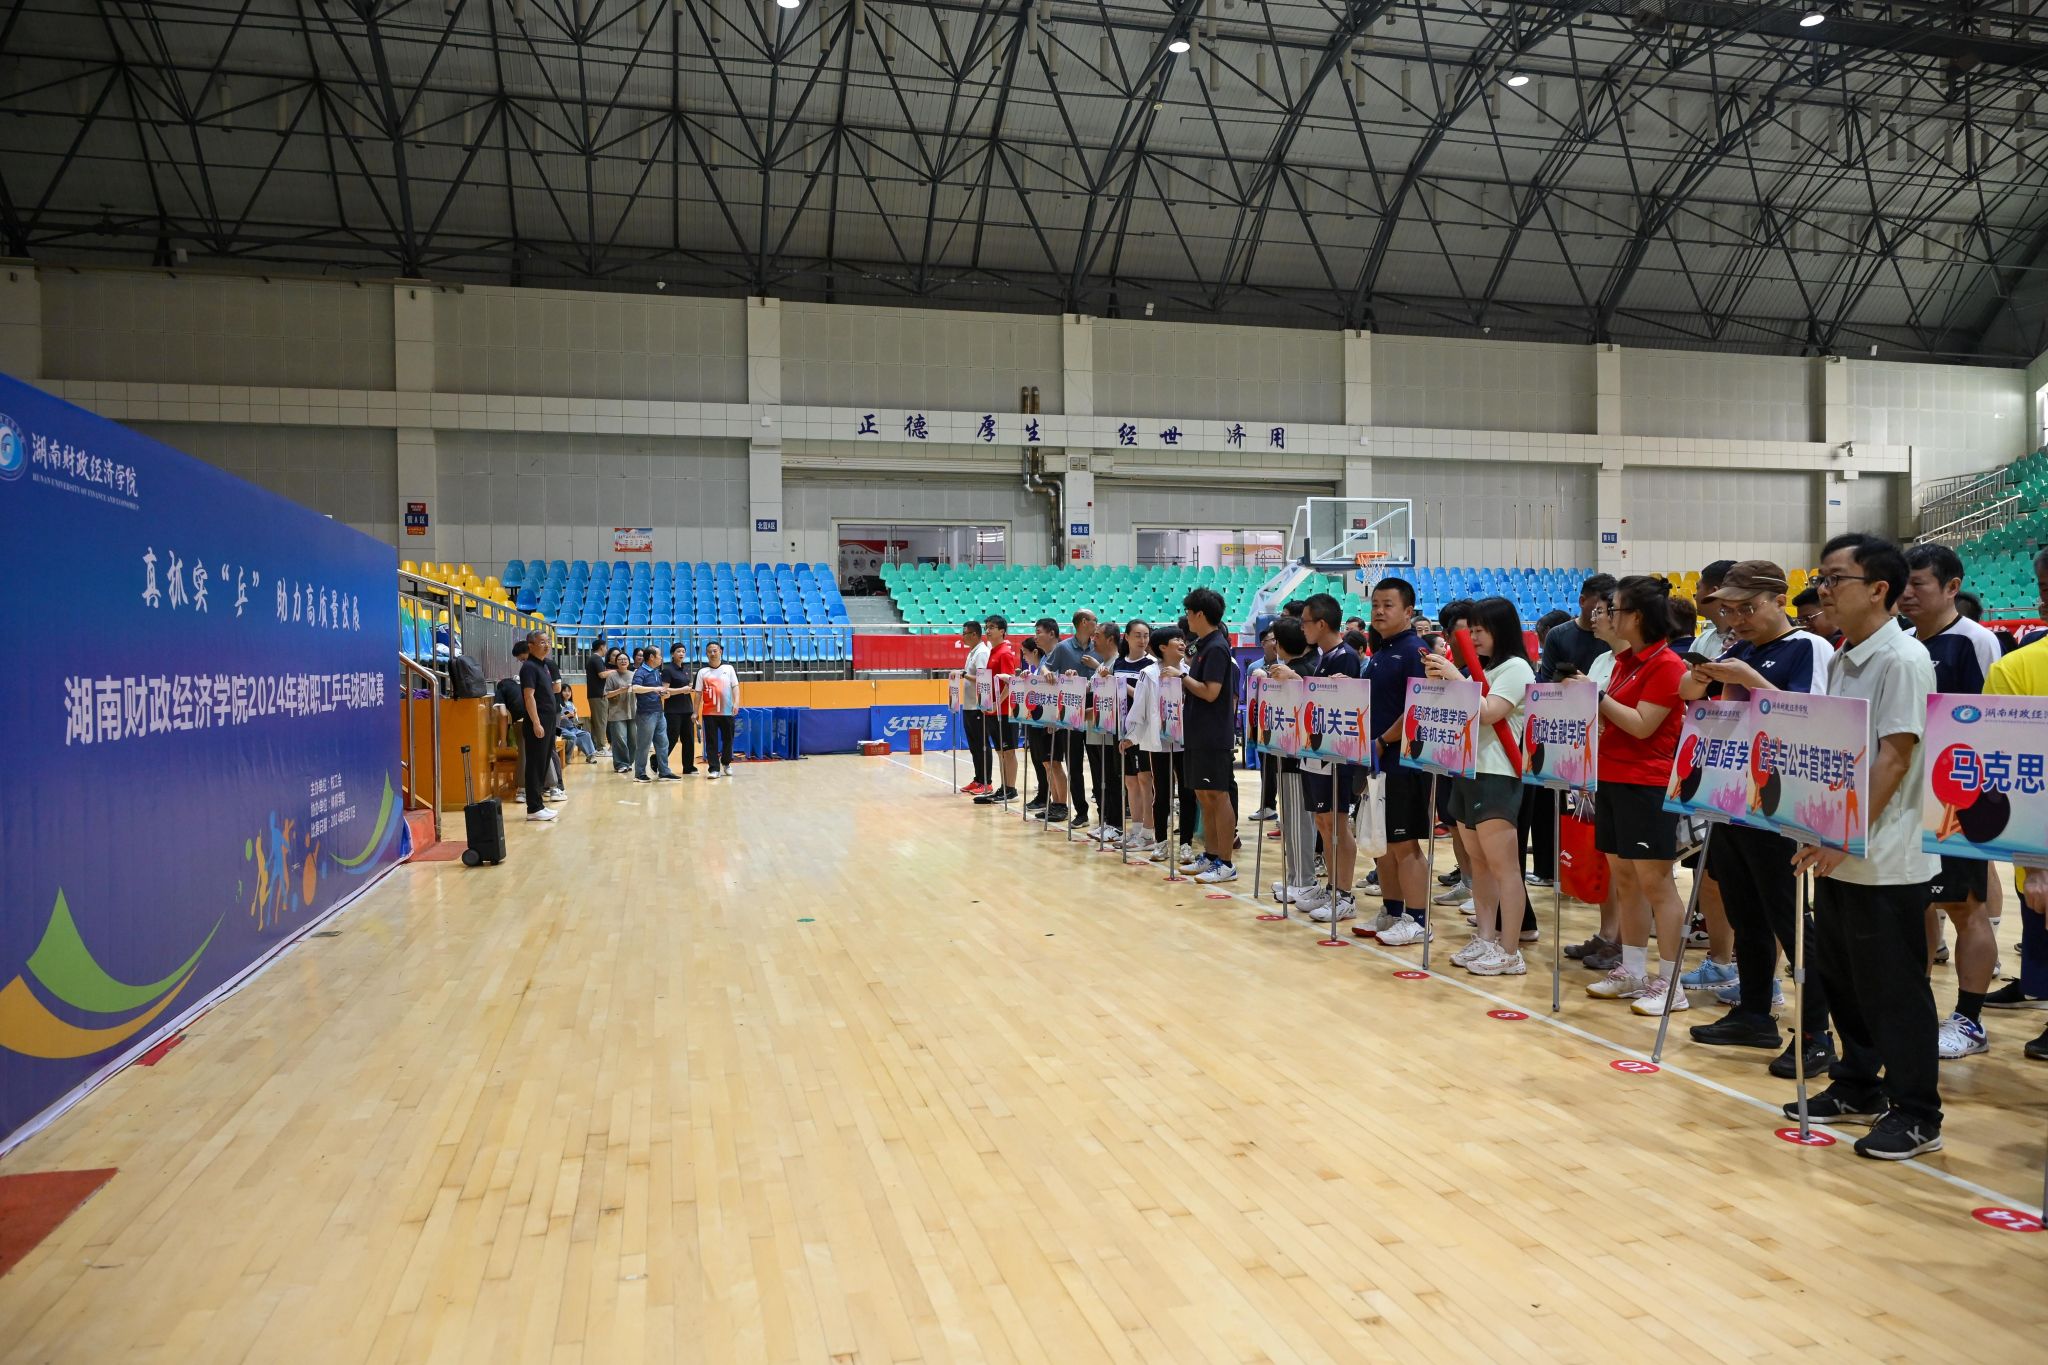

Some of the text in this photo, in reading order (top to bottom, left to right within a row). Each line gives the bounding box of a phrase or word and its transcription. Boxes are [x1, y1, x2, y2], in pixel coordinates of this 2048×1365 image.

[32, 432, 138, 497] 湖南财政经济学院
[276, 578, 361, 632] 助力高质量发展
[64, 671, 384, 746] 湖南财政经济学院2024年教职工乒乓球团体赛
[1264, 704, 1296, 731] 机关一
[1312, 706, 1359, 737] 机关三
[1414, 704, 1468, 726] 经济地理学院
[922, 731, 946, 741] HS
[1532, 717, 1587, 747] 财政金融学院
[1692, 736, 1749, 772] 外国语学
[1759, 735, 1855, 791] 法学与公共管理学院
[1950, 749, 2045, 795] 马克思
[1618, 1061, 1654, 1072] 10
[1983, 1211, 2041, 1230] 14
